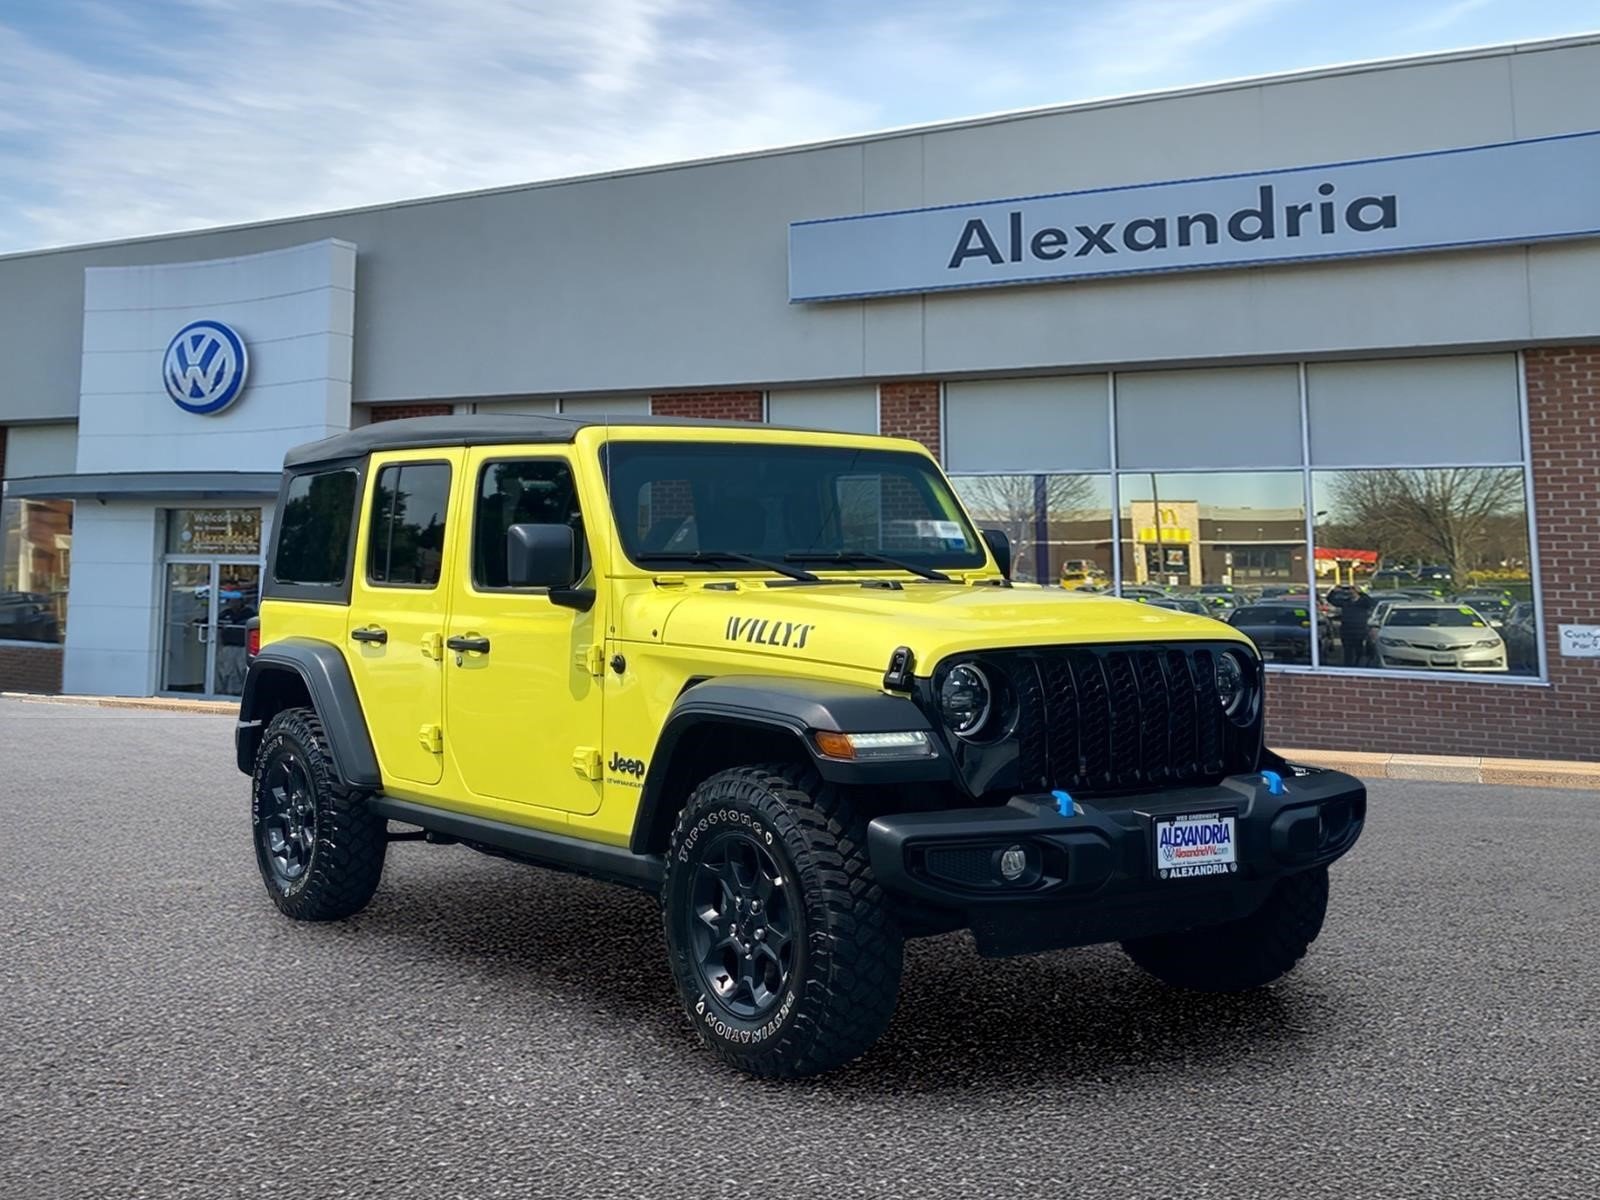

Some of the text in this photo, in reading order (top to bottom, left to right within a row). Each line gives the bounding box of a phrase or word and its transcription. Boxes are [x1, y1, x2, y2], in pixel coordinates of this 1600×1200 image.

[947, 182, 1398, 269] Alexandria
[725, 616, 816, 649] WILLYS
[608, 751, 645, 780] Jeep
[1160, 823, 1230, 848] ALEXANDRIA
[1169, 863, 1228, 878] ALEXANDRIA
